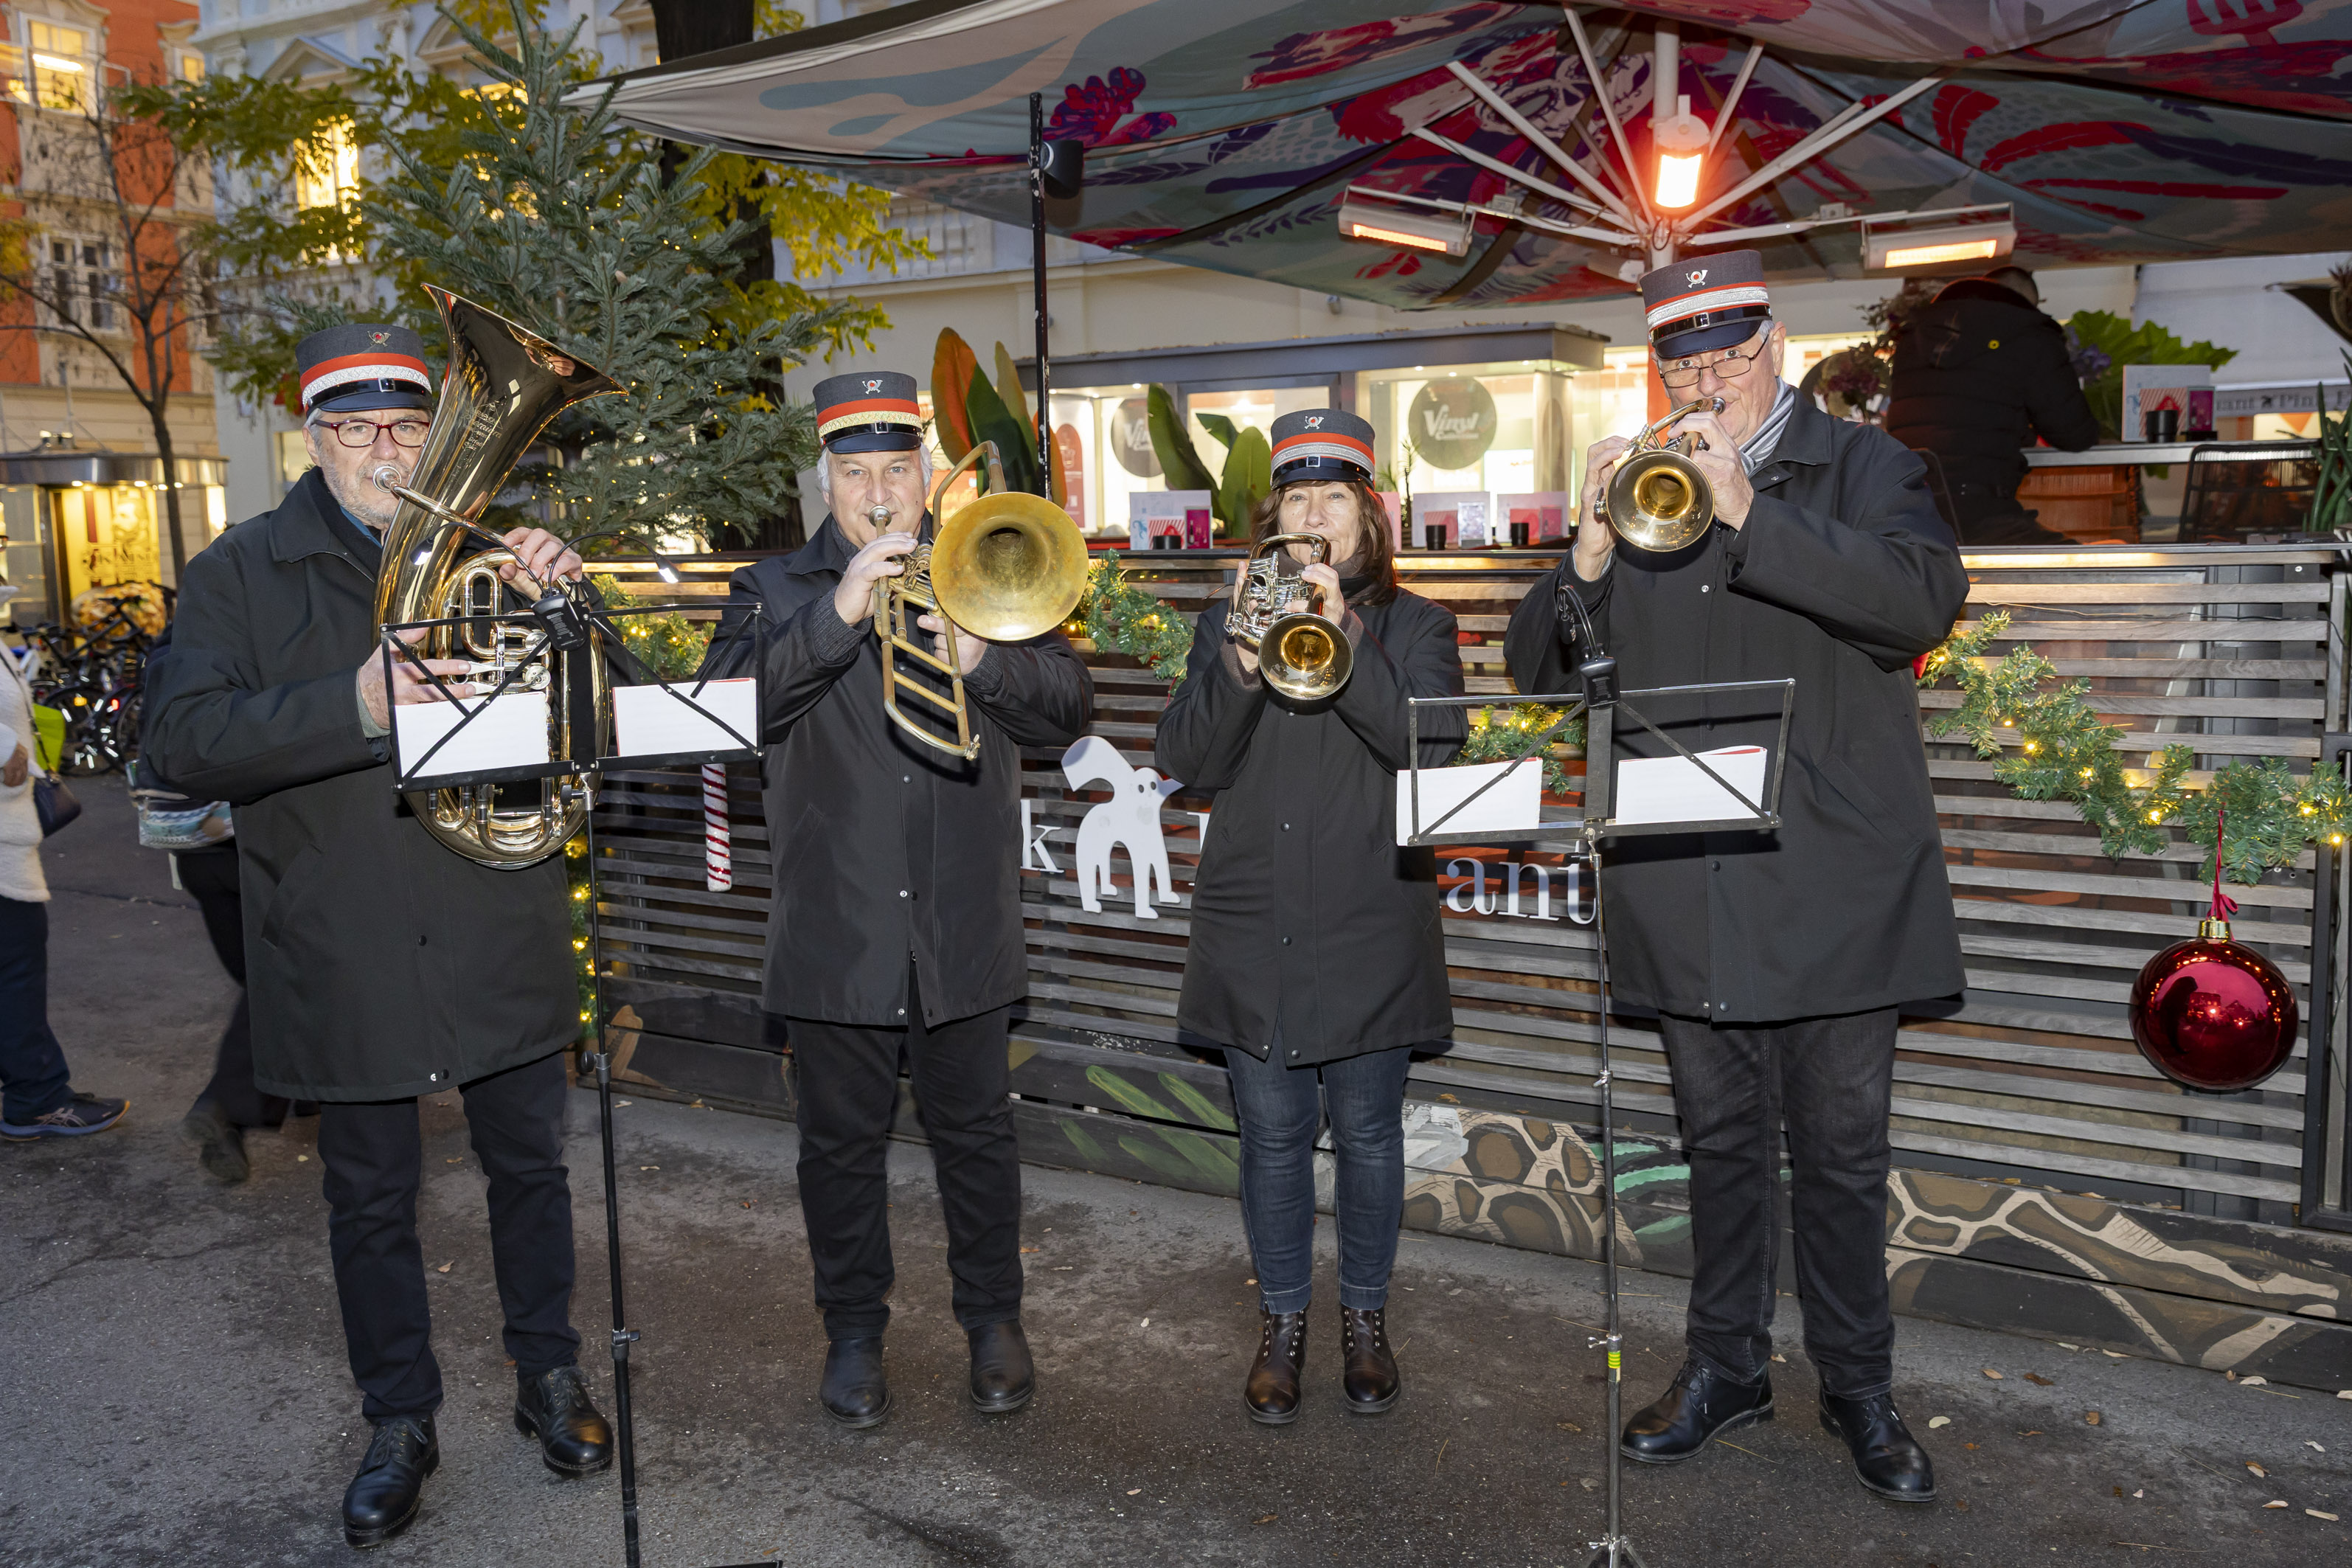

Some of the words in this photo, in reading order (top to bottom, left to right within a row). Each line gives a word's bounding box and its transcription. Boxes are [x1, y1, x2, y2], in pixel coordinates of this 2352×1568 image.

[2279, 393, 2314, 407] Pin
[1423, 403, 1479, 437] Vinyl
[1446, 840, 1596, 924] ant
